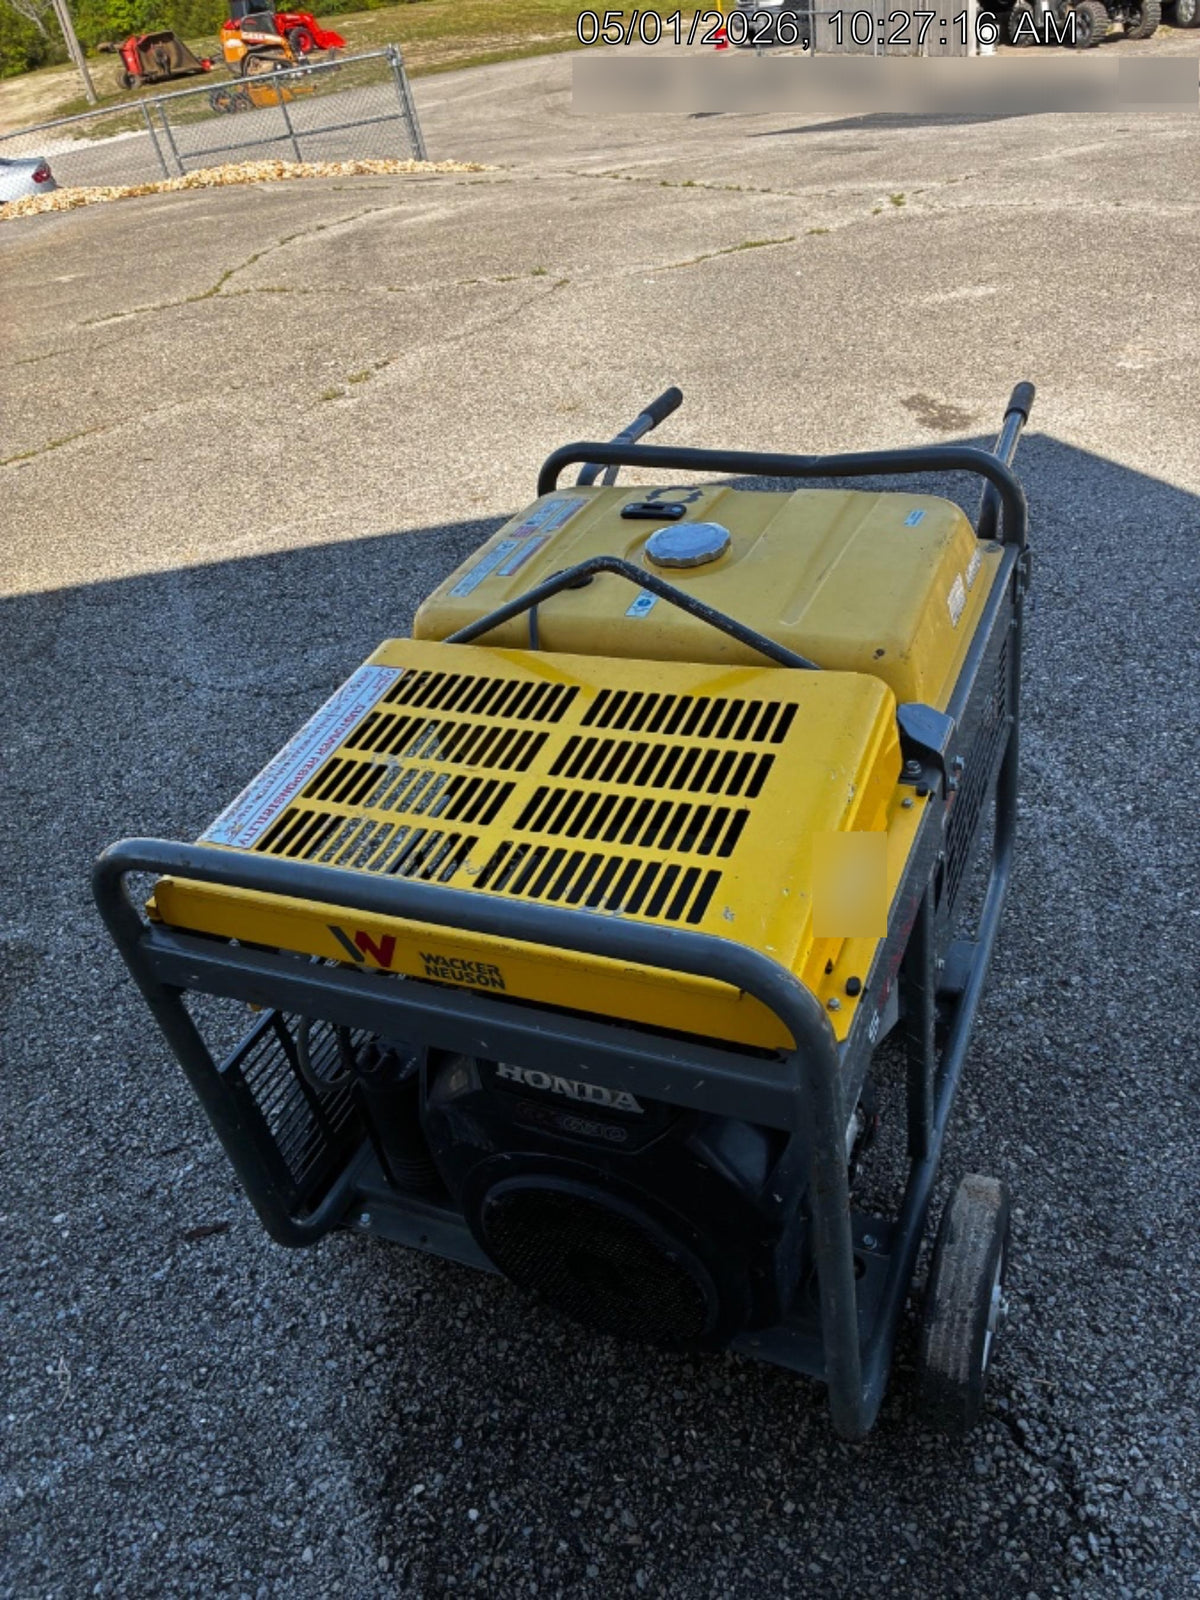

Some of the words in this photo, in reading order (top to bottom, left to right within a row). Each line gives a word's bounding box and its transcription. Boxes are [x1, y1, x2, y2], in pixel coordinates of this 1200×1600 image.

[318, 703, 367, 756] CUSTOMER
[239, 756, 319, 845] RESPONSIBILITY
[419, 951, 500, 977] WACKER
[424, 965, 506, 990] NEUSON
[495, 1062, 645, 1114] HONDA
